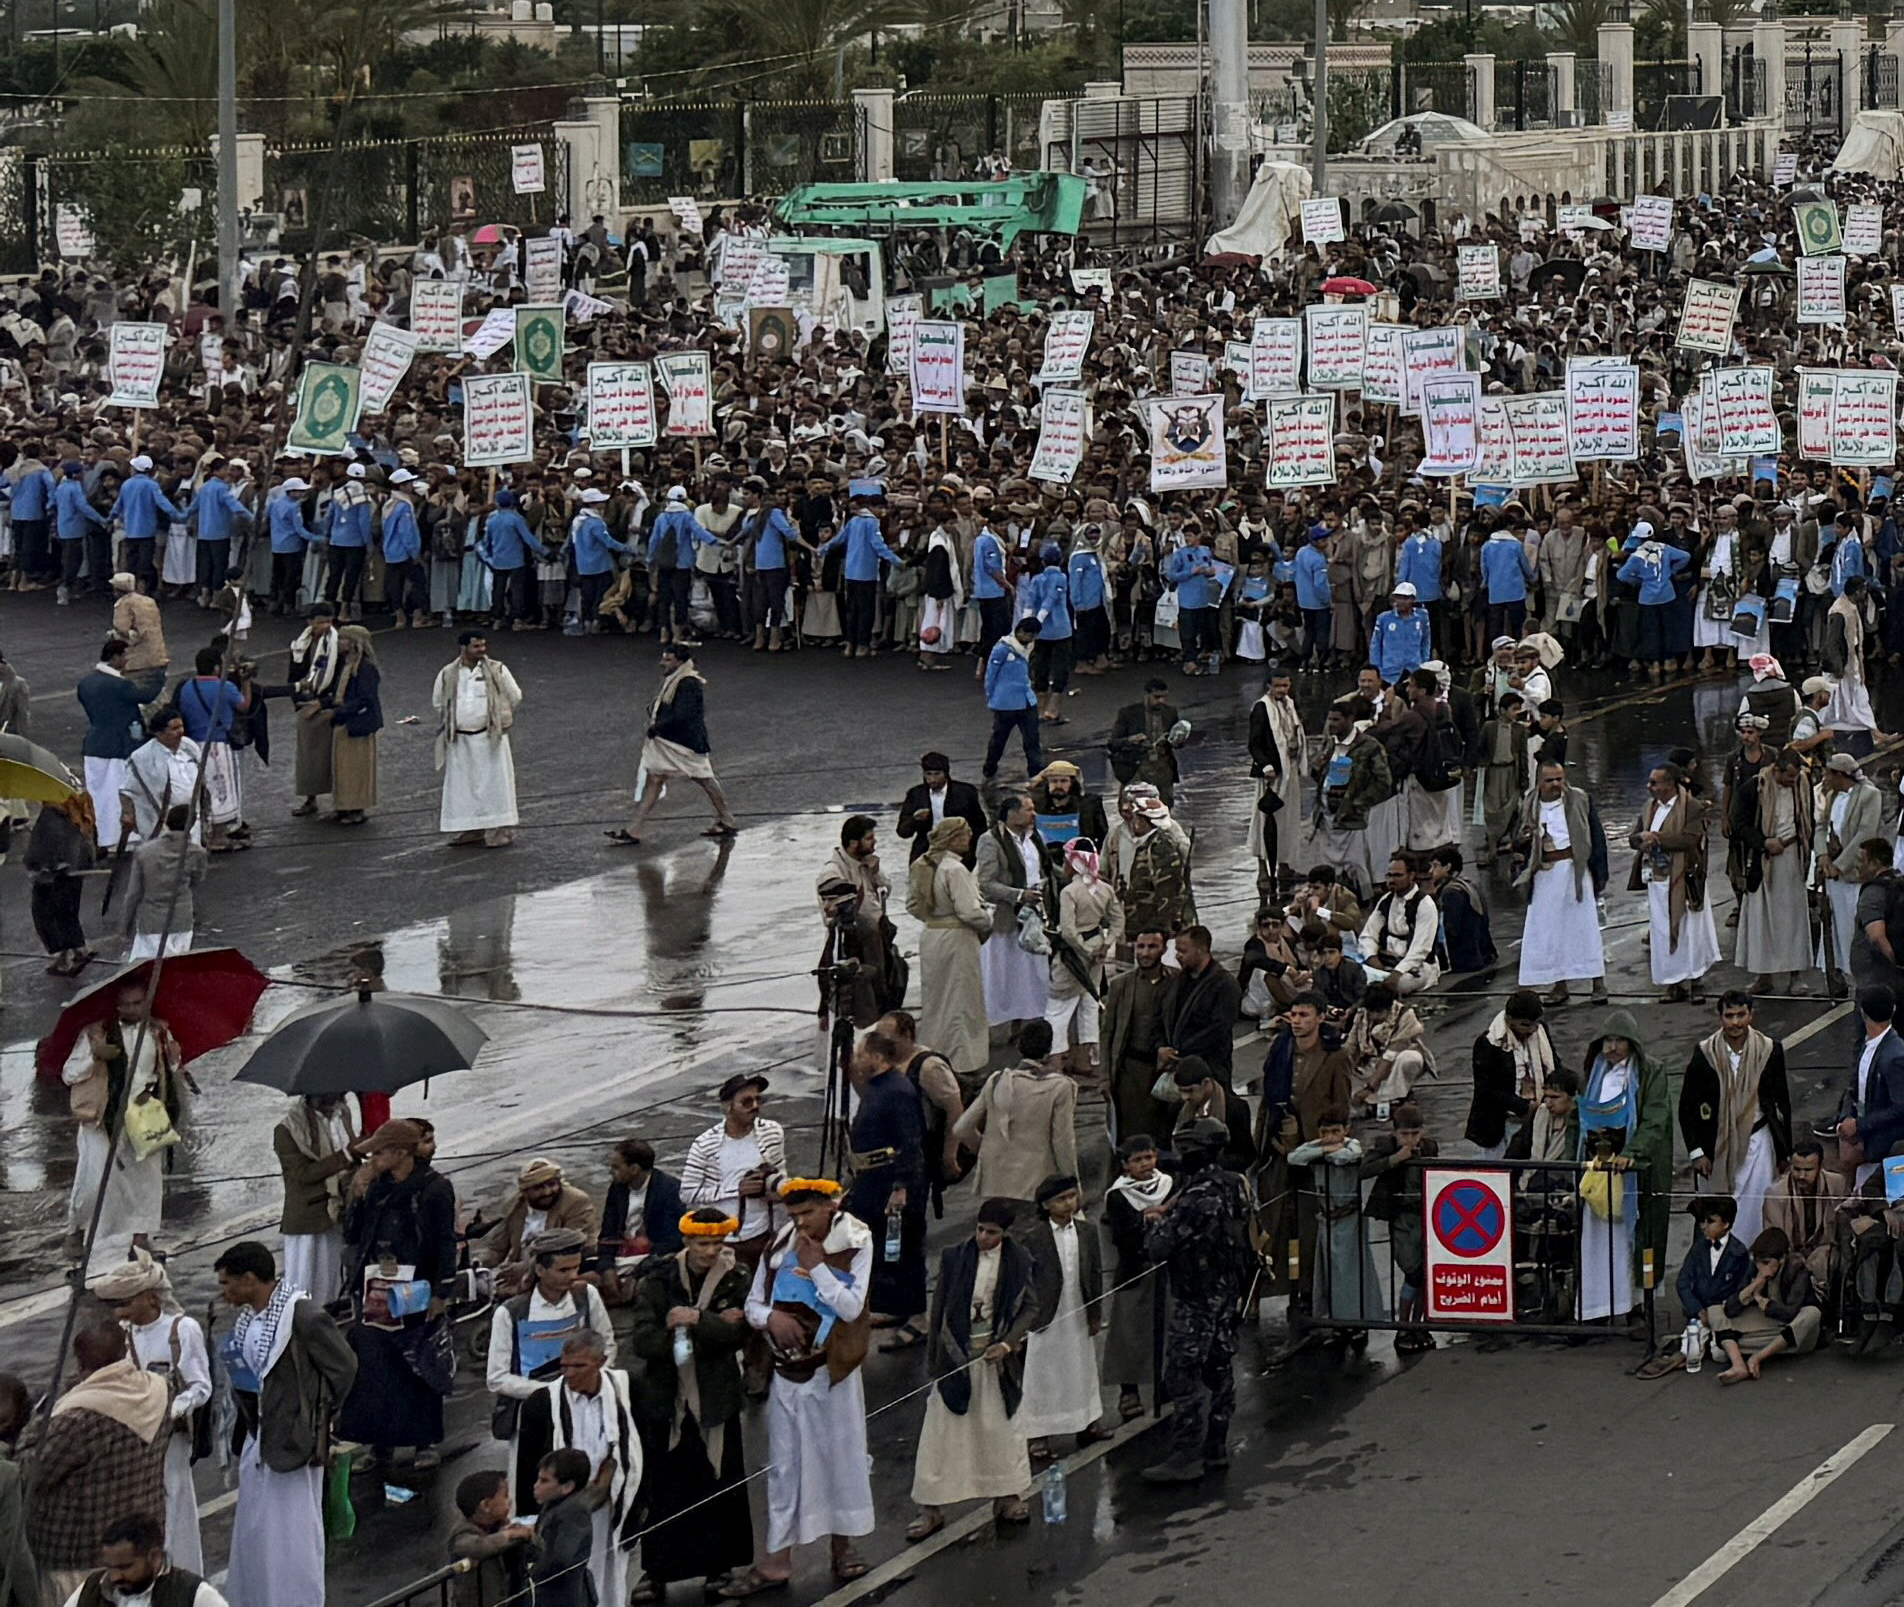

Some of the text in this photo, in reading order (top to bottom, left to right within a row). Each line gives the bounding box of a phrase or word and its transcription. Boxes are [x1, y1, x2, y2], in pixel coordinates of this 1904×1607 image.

[1436, 1273, 1504, 1288] ممنوع الوقوف
[1439, 1290, 1502, 1306] أمام الضريح
